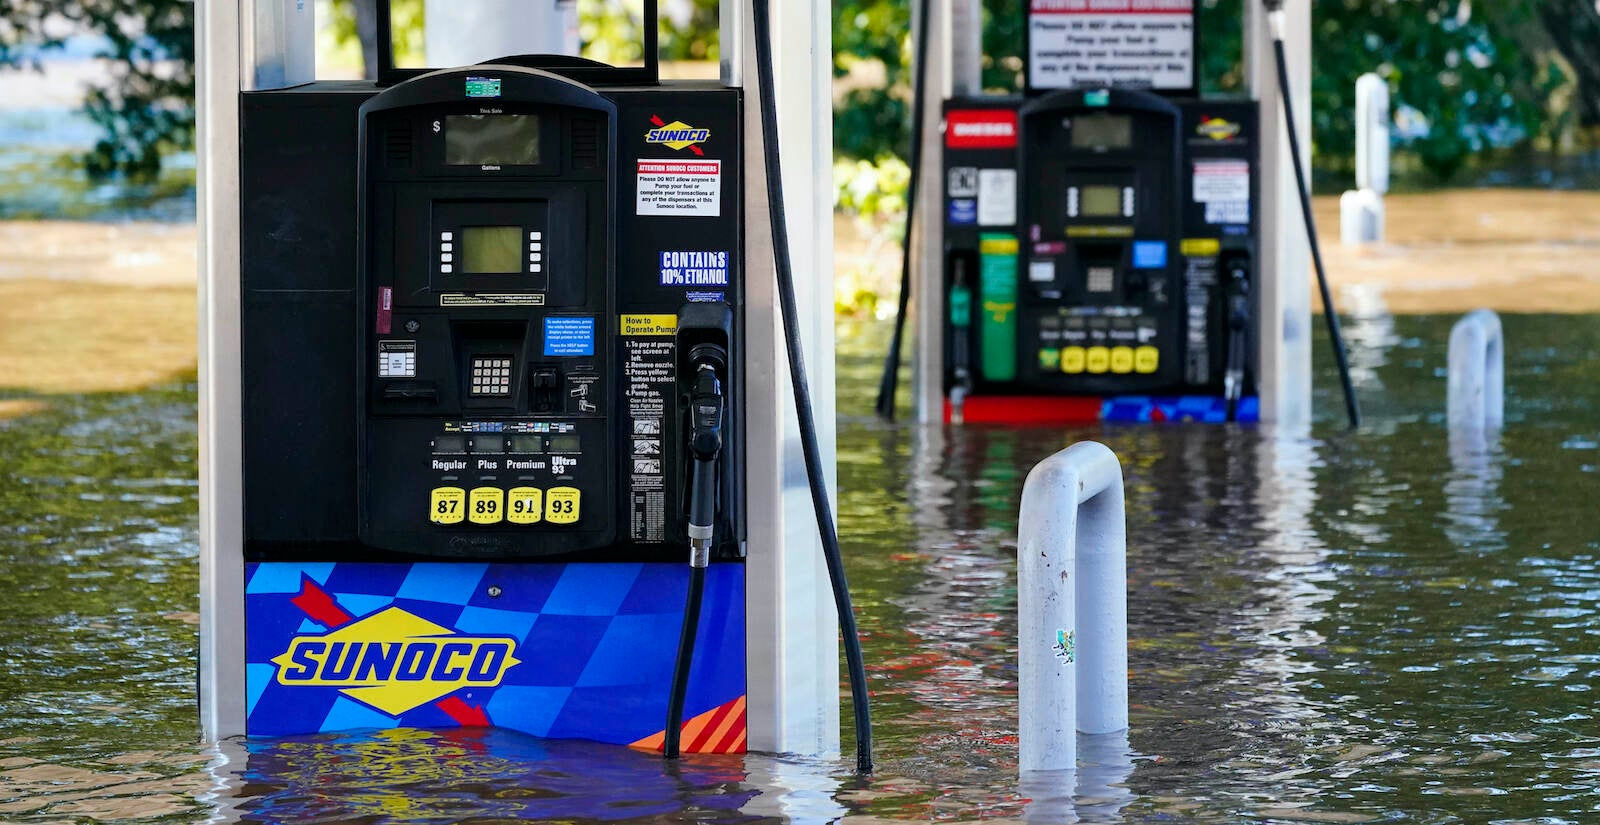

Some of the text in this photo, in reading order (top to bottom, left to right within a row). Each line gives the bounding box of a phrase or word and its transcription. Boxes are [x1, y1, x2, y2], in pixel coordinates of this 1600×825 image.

[433, 121, 440, 132] $
[648, 130, 708, 141] SUNOCO
[663, 251, 726, 268] CONTAINS
[661, 268, 728, 284] 10% ETHANOL
[625, 326, 676, 334] Operate Pump
[432, 460, 467, 471] Regular
[478, 460, 497, 469] Plus
[507, 460, 545, 469] Premium
[551, 456, 577, 466] Ultra
[551, 466, 565, 474] 93
[437, 500, 459, 514] 87
[475, 500, 497, 514] 89
[514, 500, 534, 514] 91
[552, 500, 573, 514] 93
[284, 641, 509, 681] SUNOCO
